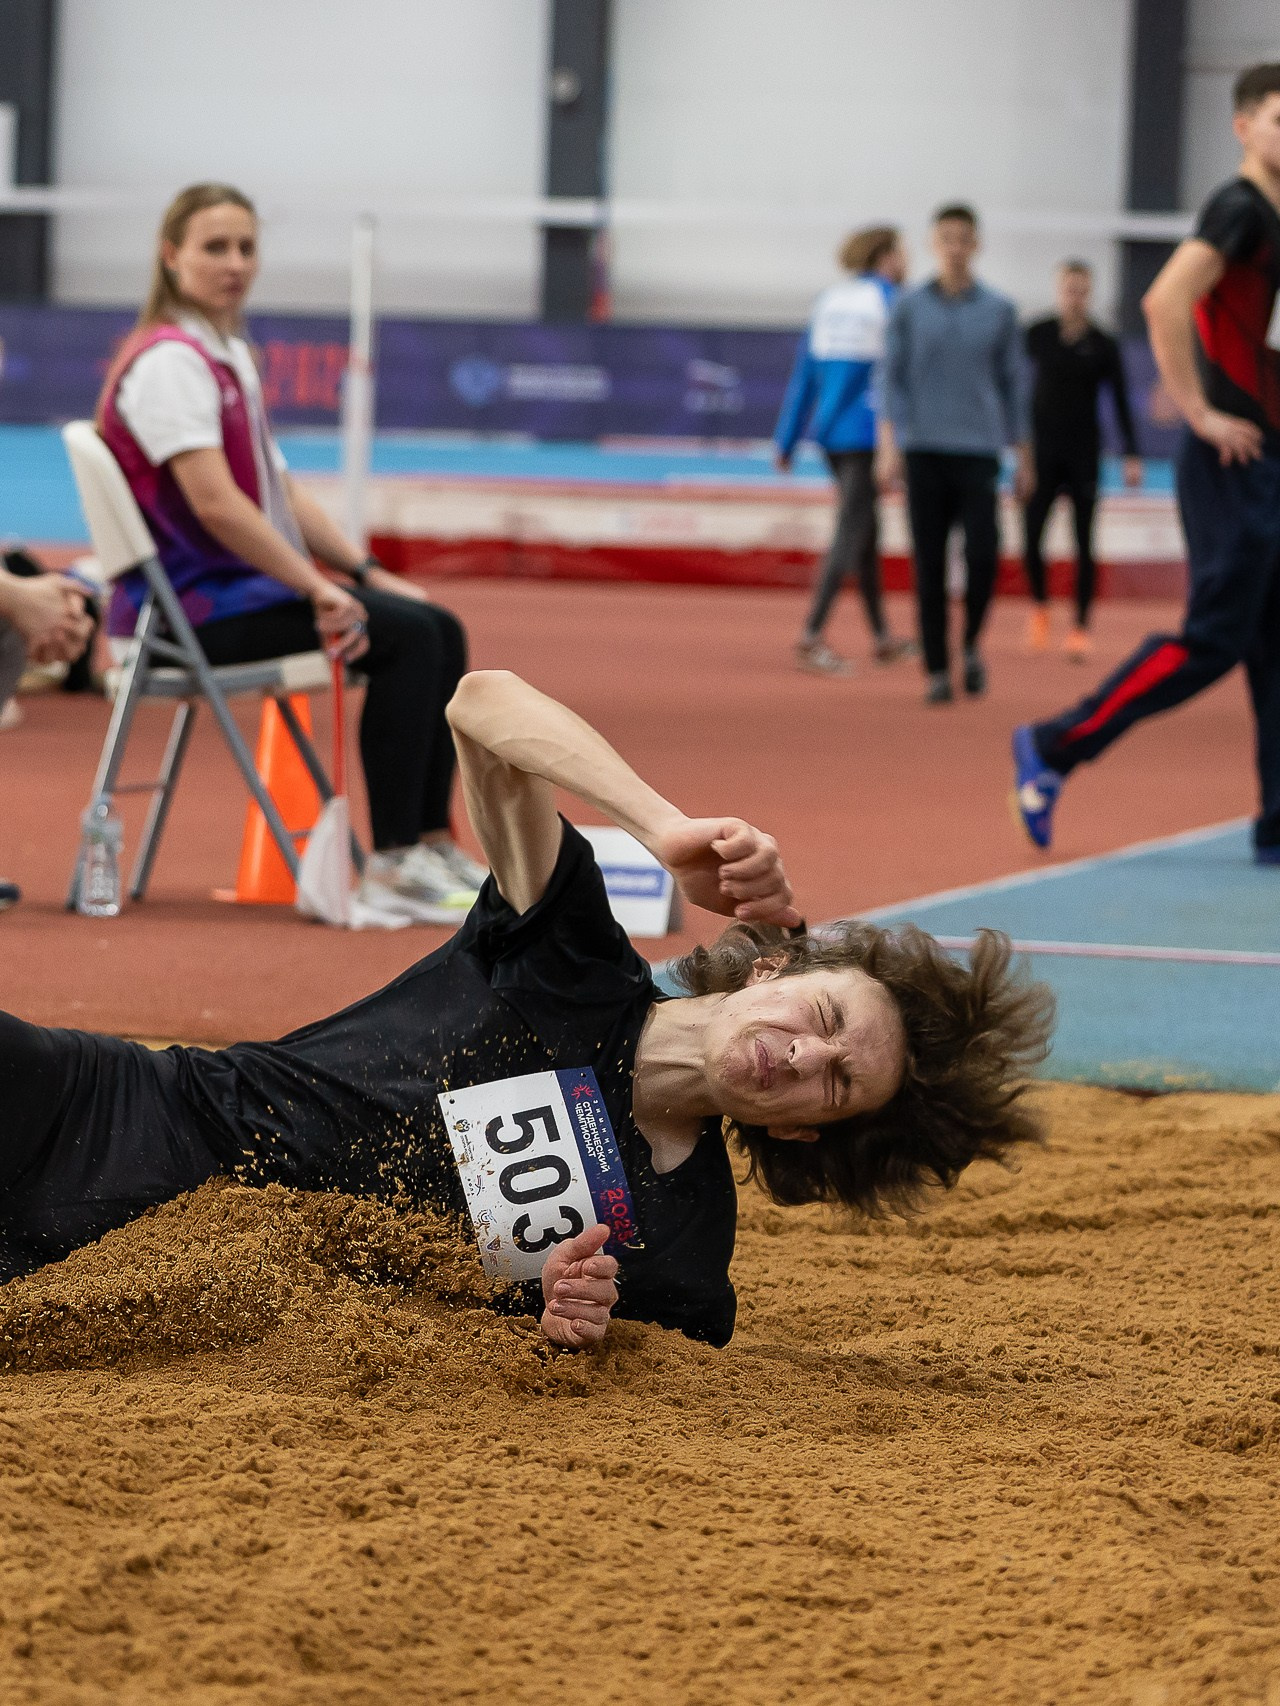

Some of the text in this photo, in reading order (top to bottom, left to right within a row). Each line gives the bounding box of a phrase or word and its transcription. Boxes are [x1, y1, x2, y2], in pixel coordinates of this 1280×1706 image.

[575, 1102, 597, 1158] ЧЕМПИОНАТ
[582, 1101, 611, 1173] СТУДЕНЧЕСКИЙ
[484, 1104, 585, 1254] 503
[607, 1187, 635, 1242] 2025
